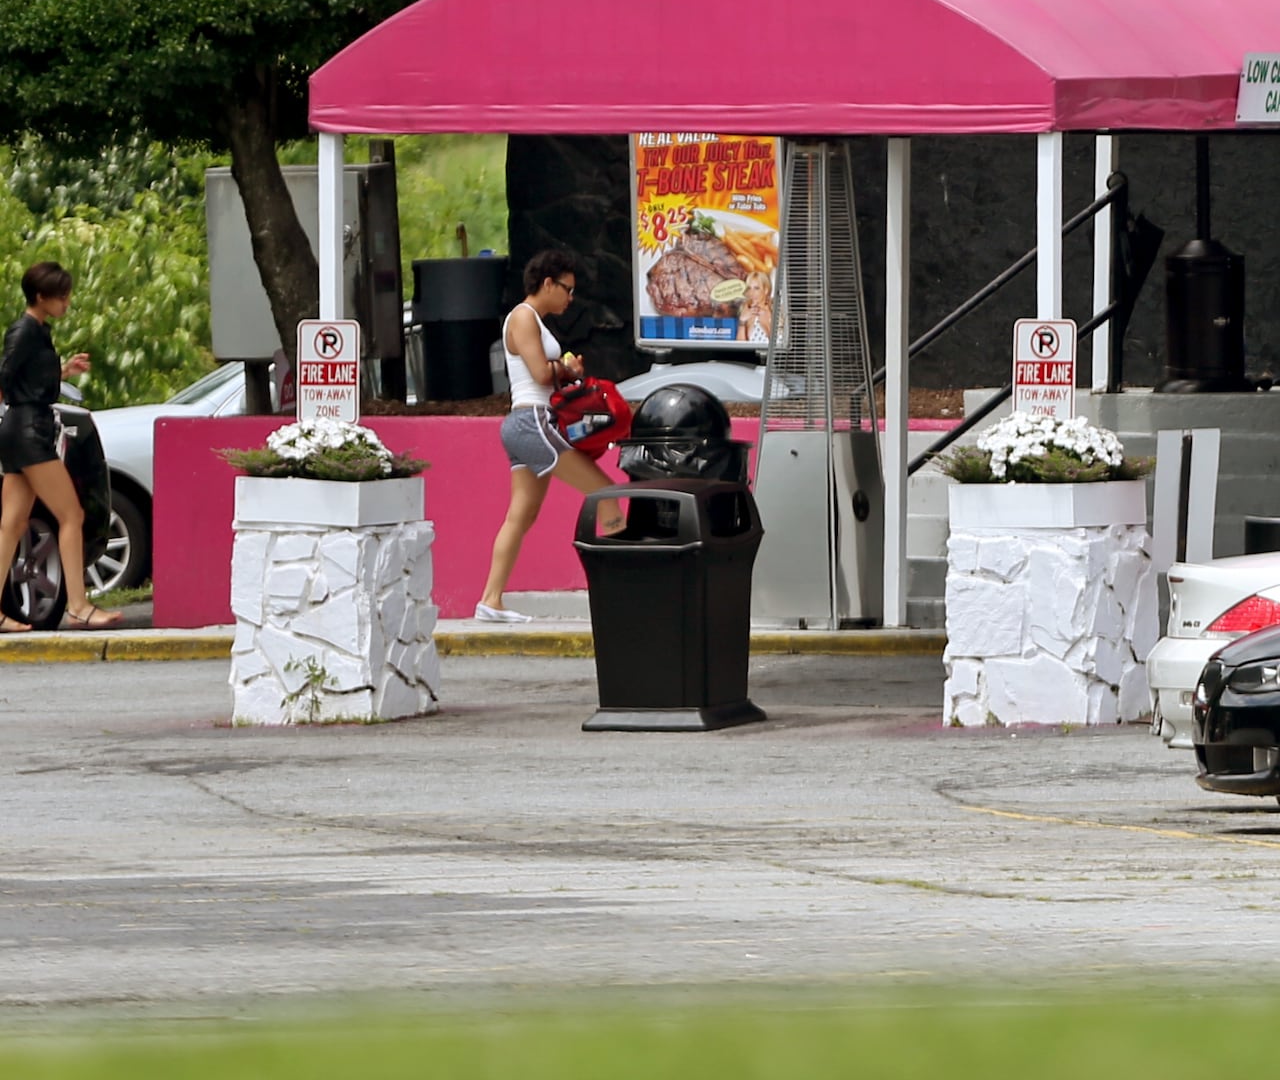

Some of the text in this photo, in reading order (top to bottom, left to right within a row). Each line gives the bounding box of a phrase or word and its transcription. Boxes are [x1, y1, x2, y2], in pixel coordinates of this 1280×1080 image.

[1246, 60, 1270, 83] LOW
[639, 132, 673, 146] REAL
[643, 146, 669, 167] TRY
[672, 144, 700, 165] OUR
[704, 141, 741, 163] JUICY
[637, 160, 775, 197] T-BONE STEAK
[647, 203, 665, 213] ONLY
[301, 364, 356, 383] FIRE LANE
[1017, 363, 1072, 383] FIRE LANE
[315, 405, 341, 417] ZONE
[1031, 405, 1056, 417] ZONE
